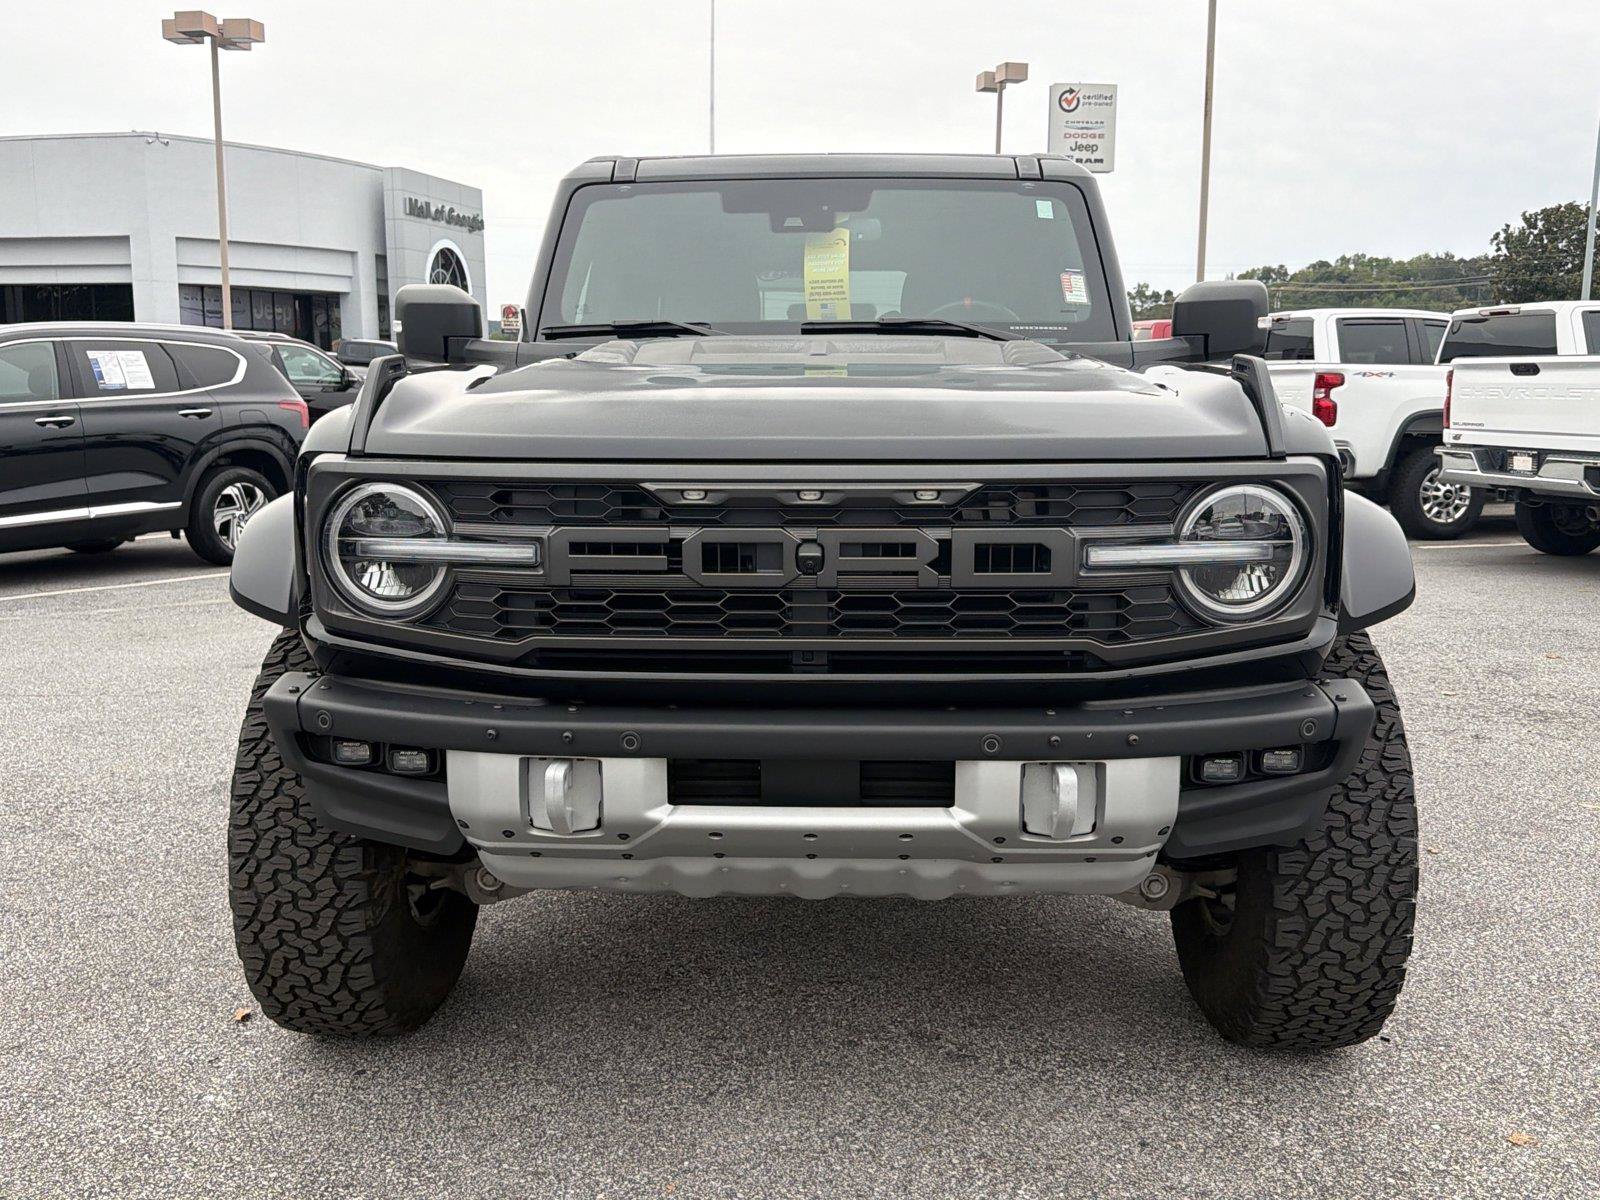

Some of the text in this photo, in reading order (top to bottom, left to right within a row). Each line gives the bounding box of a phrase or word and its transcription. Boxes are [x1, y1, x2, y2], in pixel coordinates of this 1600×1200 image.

[1070, 141, 1099, 154] Jeep
[403, 197, 484, 234] Mall of Georgia
[254, 298, 292, 326] Jeep
[1459, 386, 1600, 401] CHEVROLET
[548, 526, 1077, 588] FORD
